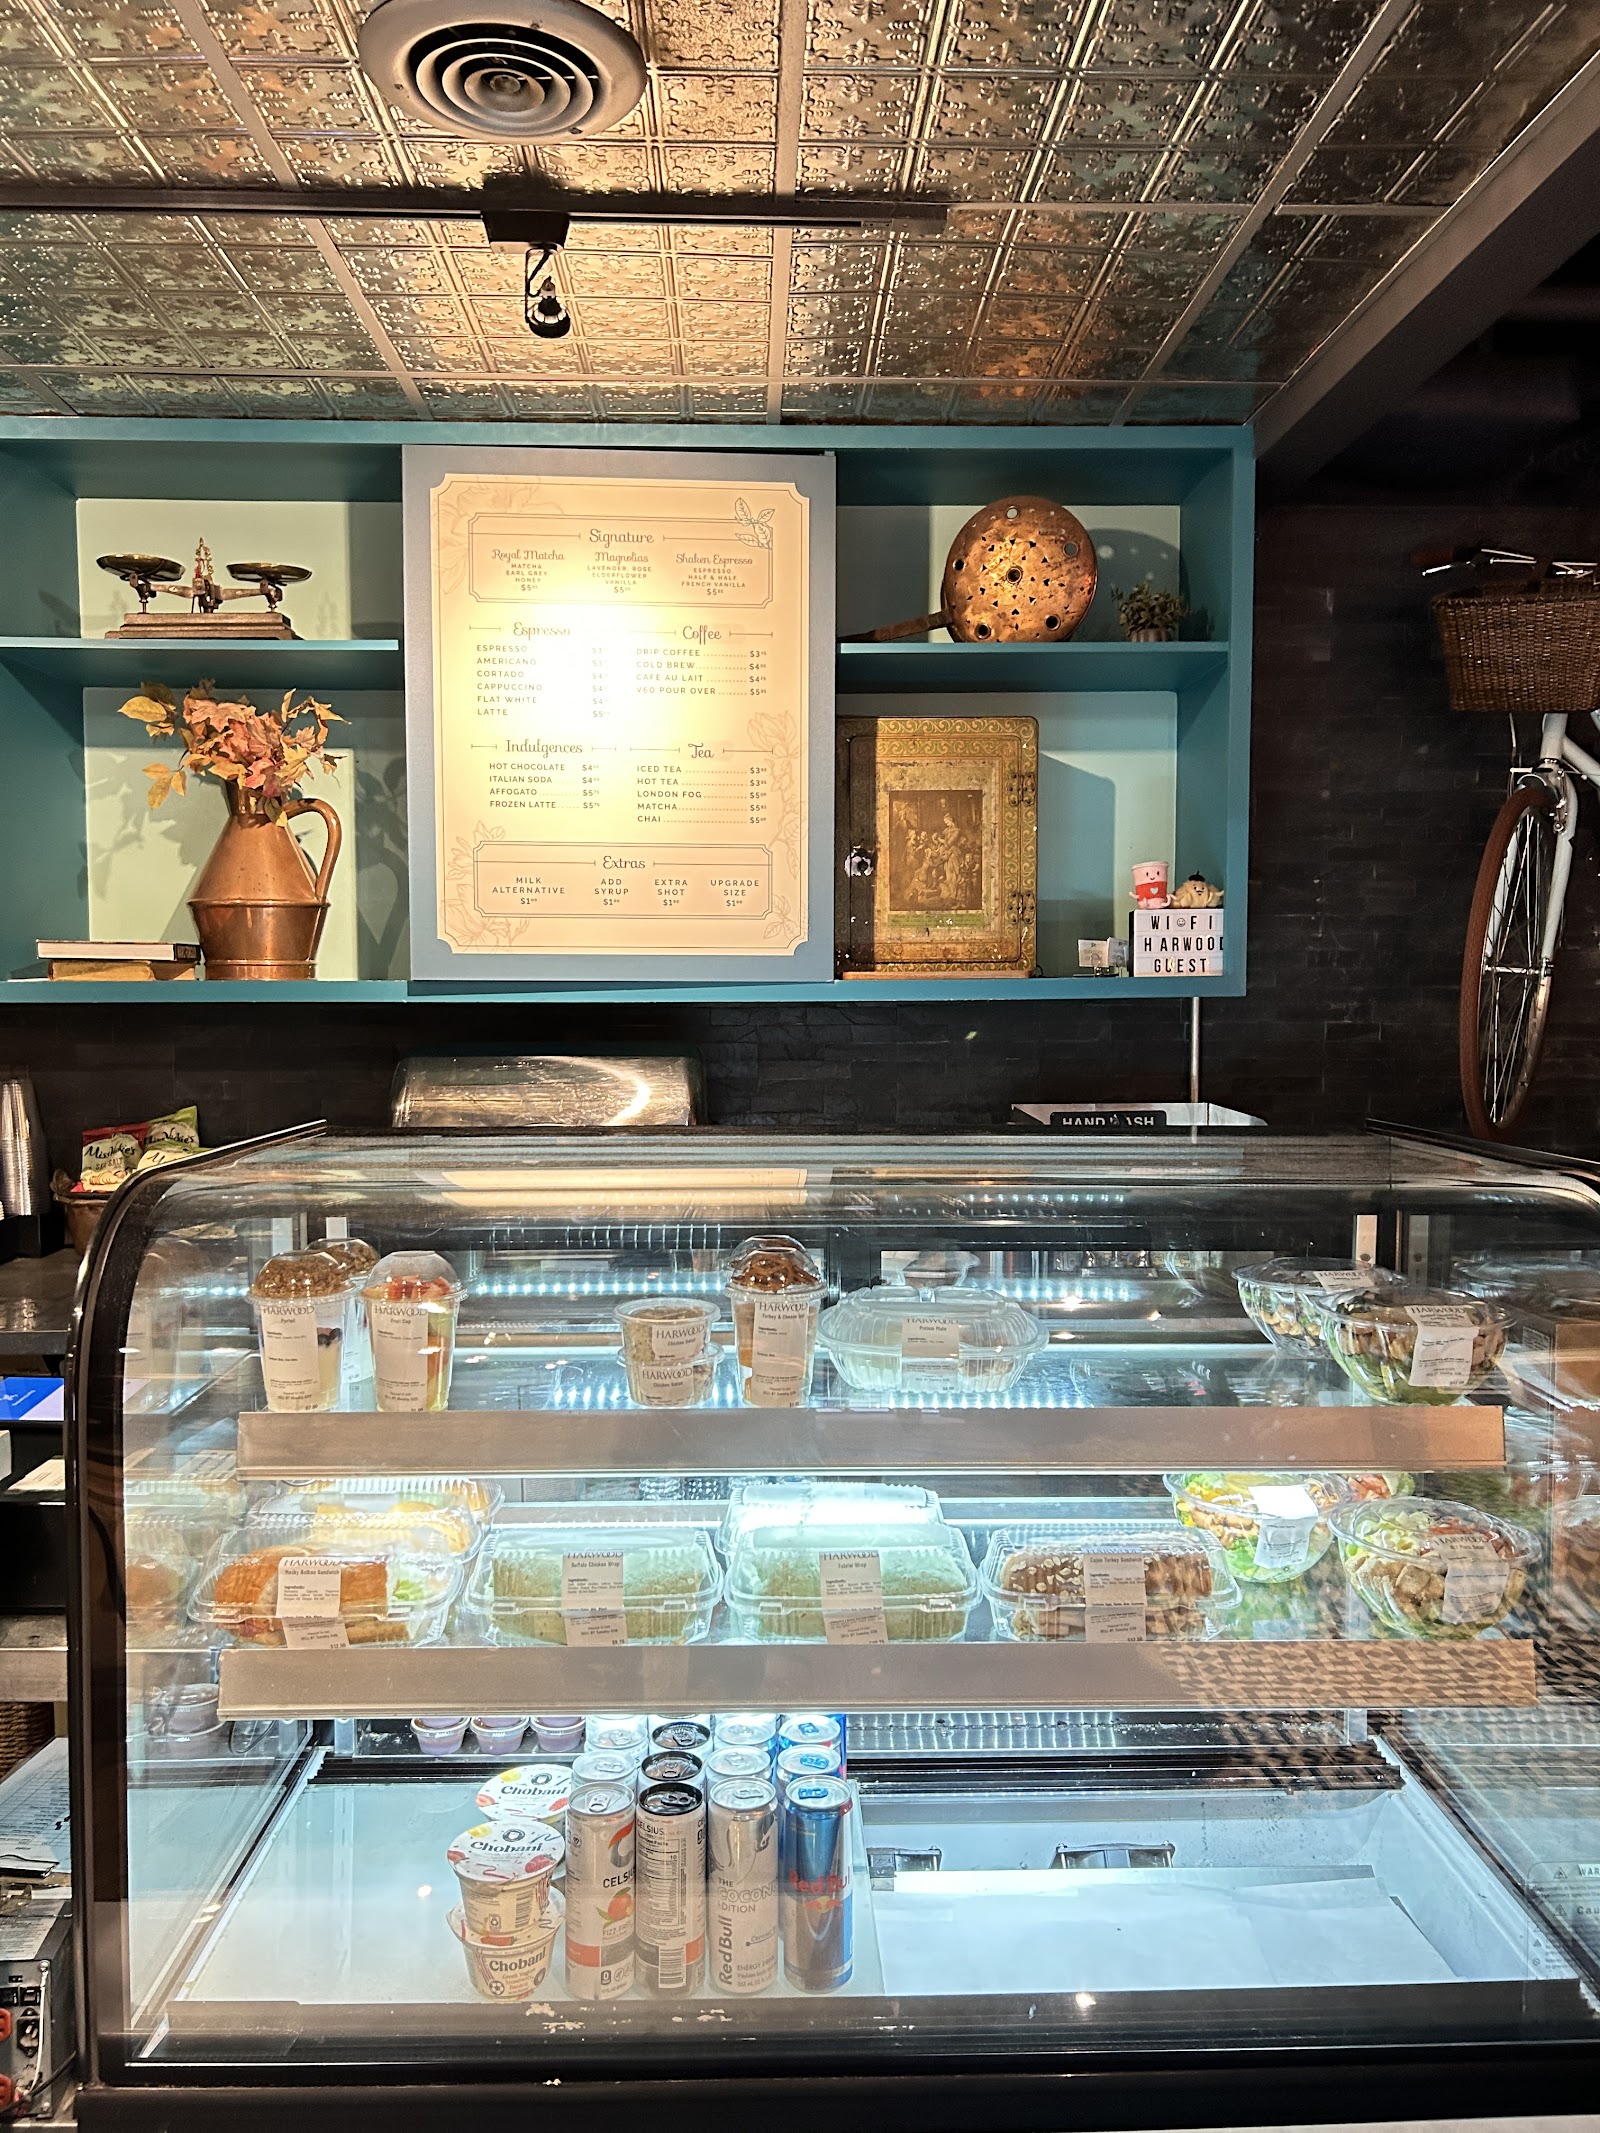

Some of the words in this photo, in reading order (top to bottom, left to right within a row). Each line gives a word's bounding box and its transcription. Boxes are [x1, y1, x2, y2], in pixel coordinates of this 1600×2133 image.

[589, 528, 655, 549] Signature
[492, 549, 521, 563] Royal
[524, 550, 565, 561] Matcha
[594, 552, 649, 566] Magnolias
[675, 554, 711, 565] Shaken
[713, 554, 753, 568] Espresso
[513, 622, 571, 641] Espresso
[682, 624, 722, 646] Coffee
[476, 644, 528, 653] ESPRESSO
[636, 648, 659, 656] DRIP
[662, 649, 700, 657] COFFEE
[476, 658, 537, 666] AMERICANO
[666, 662, 696, 670] BREW
[476, 670, 525, 678] CORTADO
[664, 674, 678, 682] AU
[682, 675, 704, 683] LAIT
[476, 683, 543, 692] CAPPUCCINO
[637, 686, 656, 694] V60
[659, 687, 686, 695] POUR
[690, 687, 716, 696] OVER
[504, 696, 537, 704] WHITE
[477, 708, 509, 716] LATTE
[505, 738, 583, 759] Indulgences
[688, 742, 715, 759] Tea
[489, 762, 508, 770] HOT
[510, 763, 566, 771] CHOCOLATE
[663, 766, 682, 774] TEA
[489, 775, 525, 783] ITALIAN
[527, 776, 553, 784] SODA
[660, 778, 679, 786] TEA
[489, 788, 538, 796] AFFOGATO
[637, 790, 679, 798] LONDON
[682, 791, 702, 799] FOG
[528, 801, 557, 809] LATTE
[637, 803, 678, 811] MATCHA
[637, 815, 661, 823] CHAI
[602, 855, 646, 870] Extras
[600, 878, 623, 886] ADD
[710, 879, 760, 887] UPGRADE
[492, 886, 566, 895] ALTERNATIVE
[594, 888, 630, 896] SYRUP
[657, 888, 686, 896] SHOT
[723, 889, 747, 897] SIZE
[1154, 958, 1207, 973] GUEST
[109, 1158, 123, 1166] SALT
[263, 1306, 315, 1316] HARWOOD
[374, 1305, 428, 1317] HARWOOD
[760, 1302, 808, 1313] HARWOOD
[656, 1324, 705, 1339] HARWOOD
[642, 1368, 693, 1380] HARWOOD
[501, 1786, 568, 1796] Chobani
[470, 1841, 543, 1853] Chobani
[718, 1878, 734, 1888] THE
[789, 1870, 824, 1895] Red
[718, 1903, 756, 1913] DITION
[718, 1914, 732, 1950] Bull
[489, 1947, 547, 1972] Chobani
[718, 1950, 732, 1985] Red
